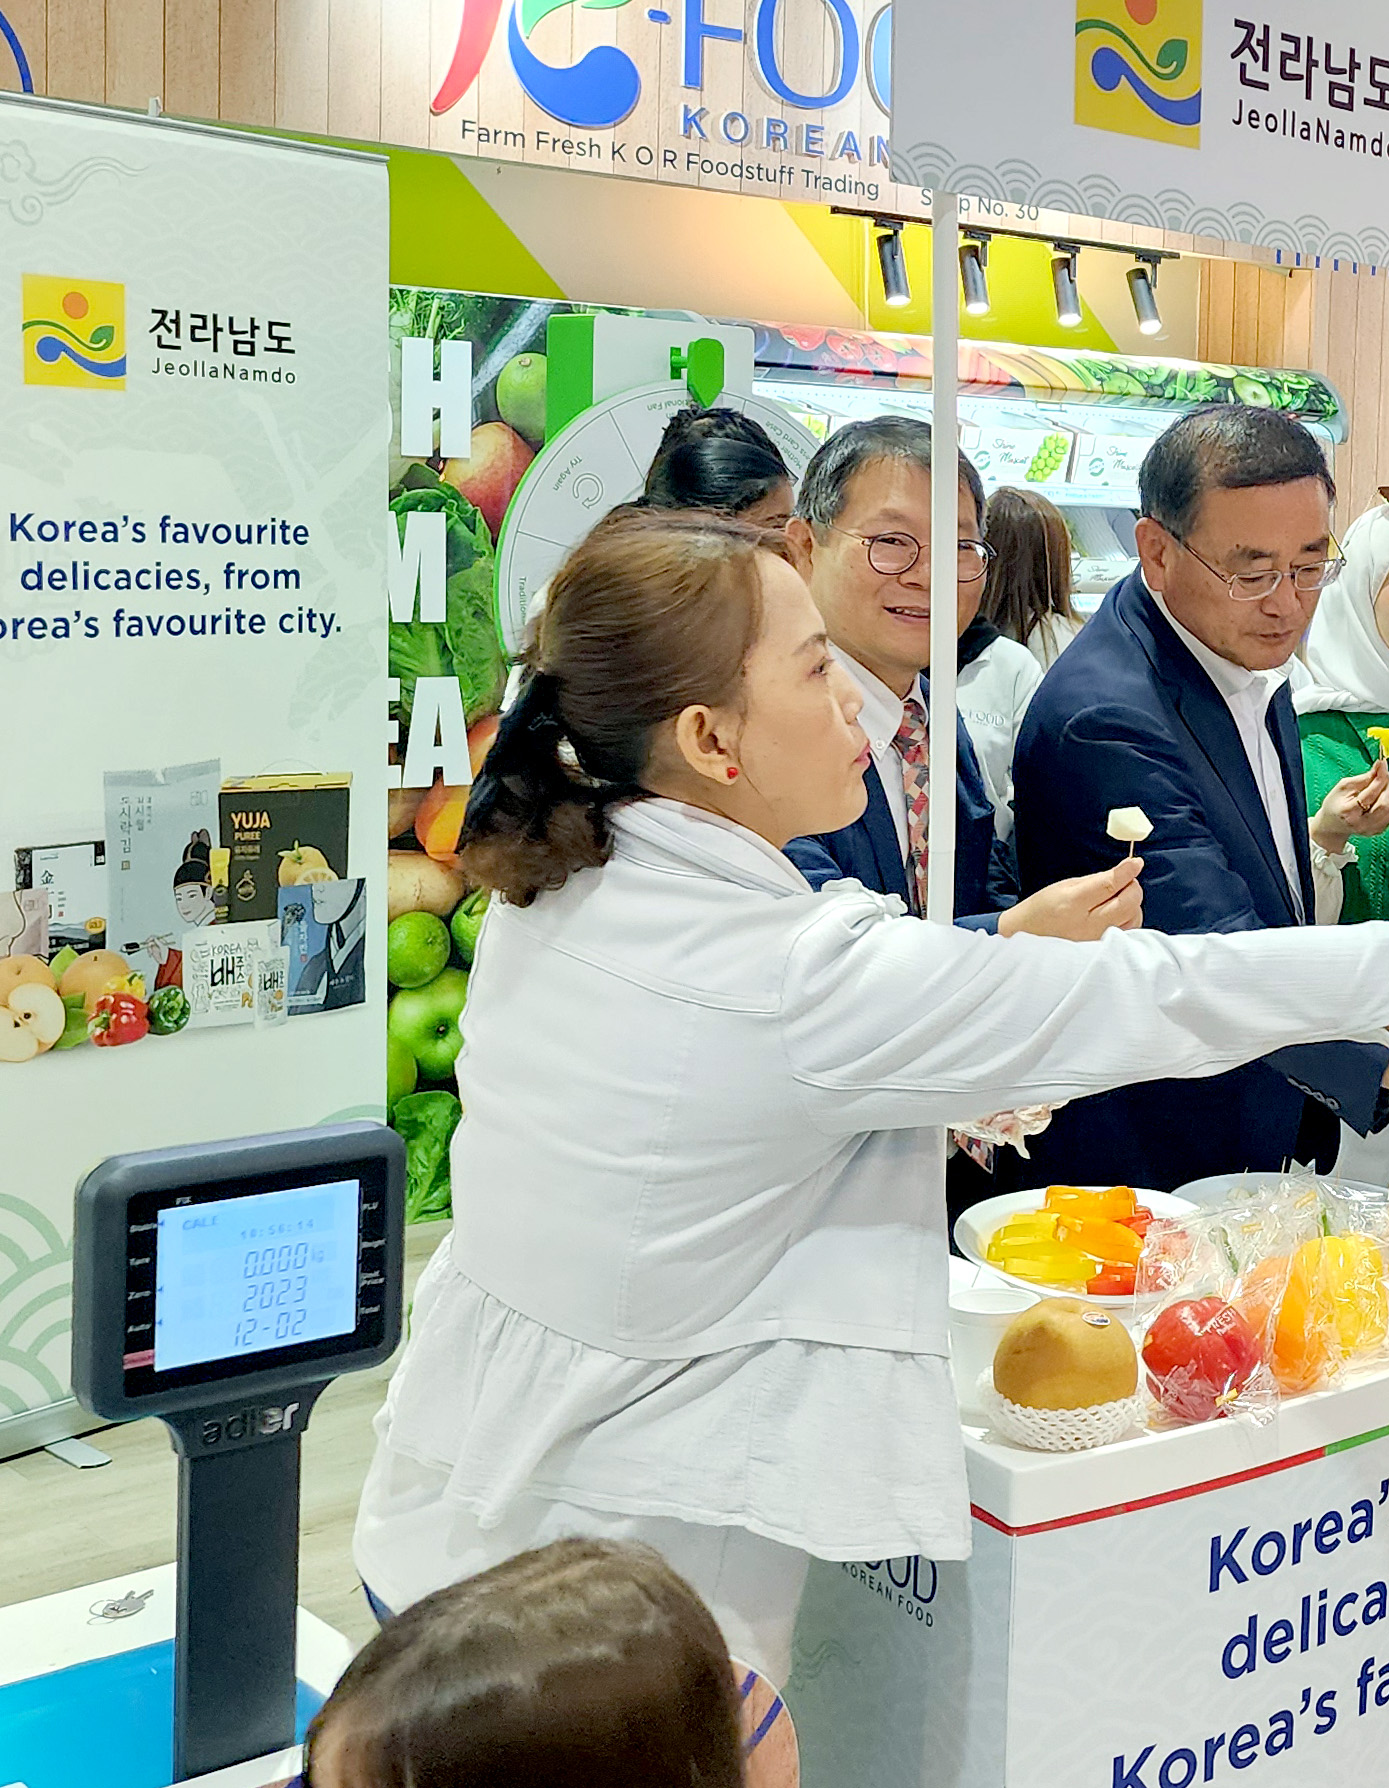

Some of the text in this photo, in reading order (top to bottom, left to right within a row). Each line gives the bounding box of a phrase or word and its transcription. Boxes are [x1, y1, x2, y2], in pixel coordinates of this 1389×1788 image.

[680, 104, 891, 168] KOREAN
[461, 119, 525, 148] Farm
[536, 132, 601, 159] Fresh
[686, 153, 795, 186] Foodstuff
[801, 170, 880, 200] Trading
[920, 188, 1039, 221] Sp No. 30
[149, 308, 296, 357] 전라남도
[152, 357, 296, 384] JeollaNamdo
[160, 515, 310, 545] favourite
[20, 561, 301, 596] delicacies, from
[113, 607, 266, 637] favourite
[278, 606, 342, 638] city.
[231, 811, 271, 830] YUJA
[210, 943, 242, 956] KOREA
[243, 1276, 308, 1312] 2023
[235, 1309, 306, 1346] 12-02
[203, 1402, 299, 1444] adler
[897, 1594, 933, 1627] FOOD
